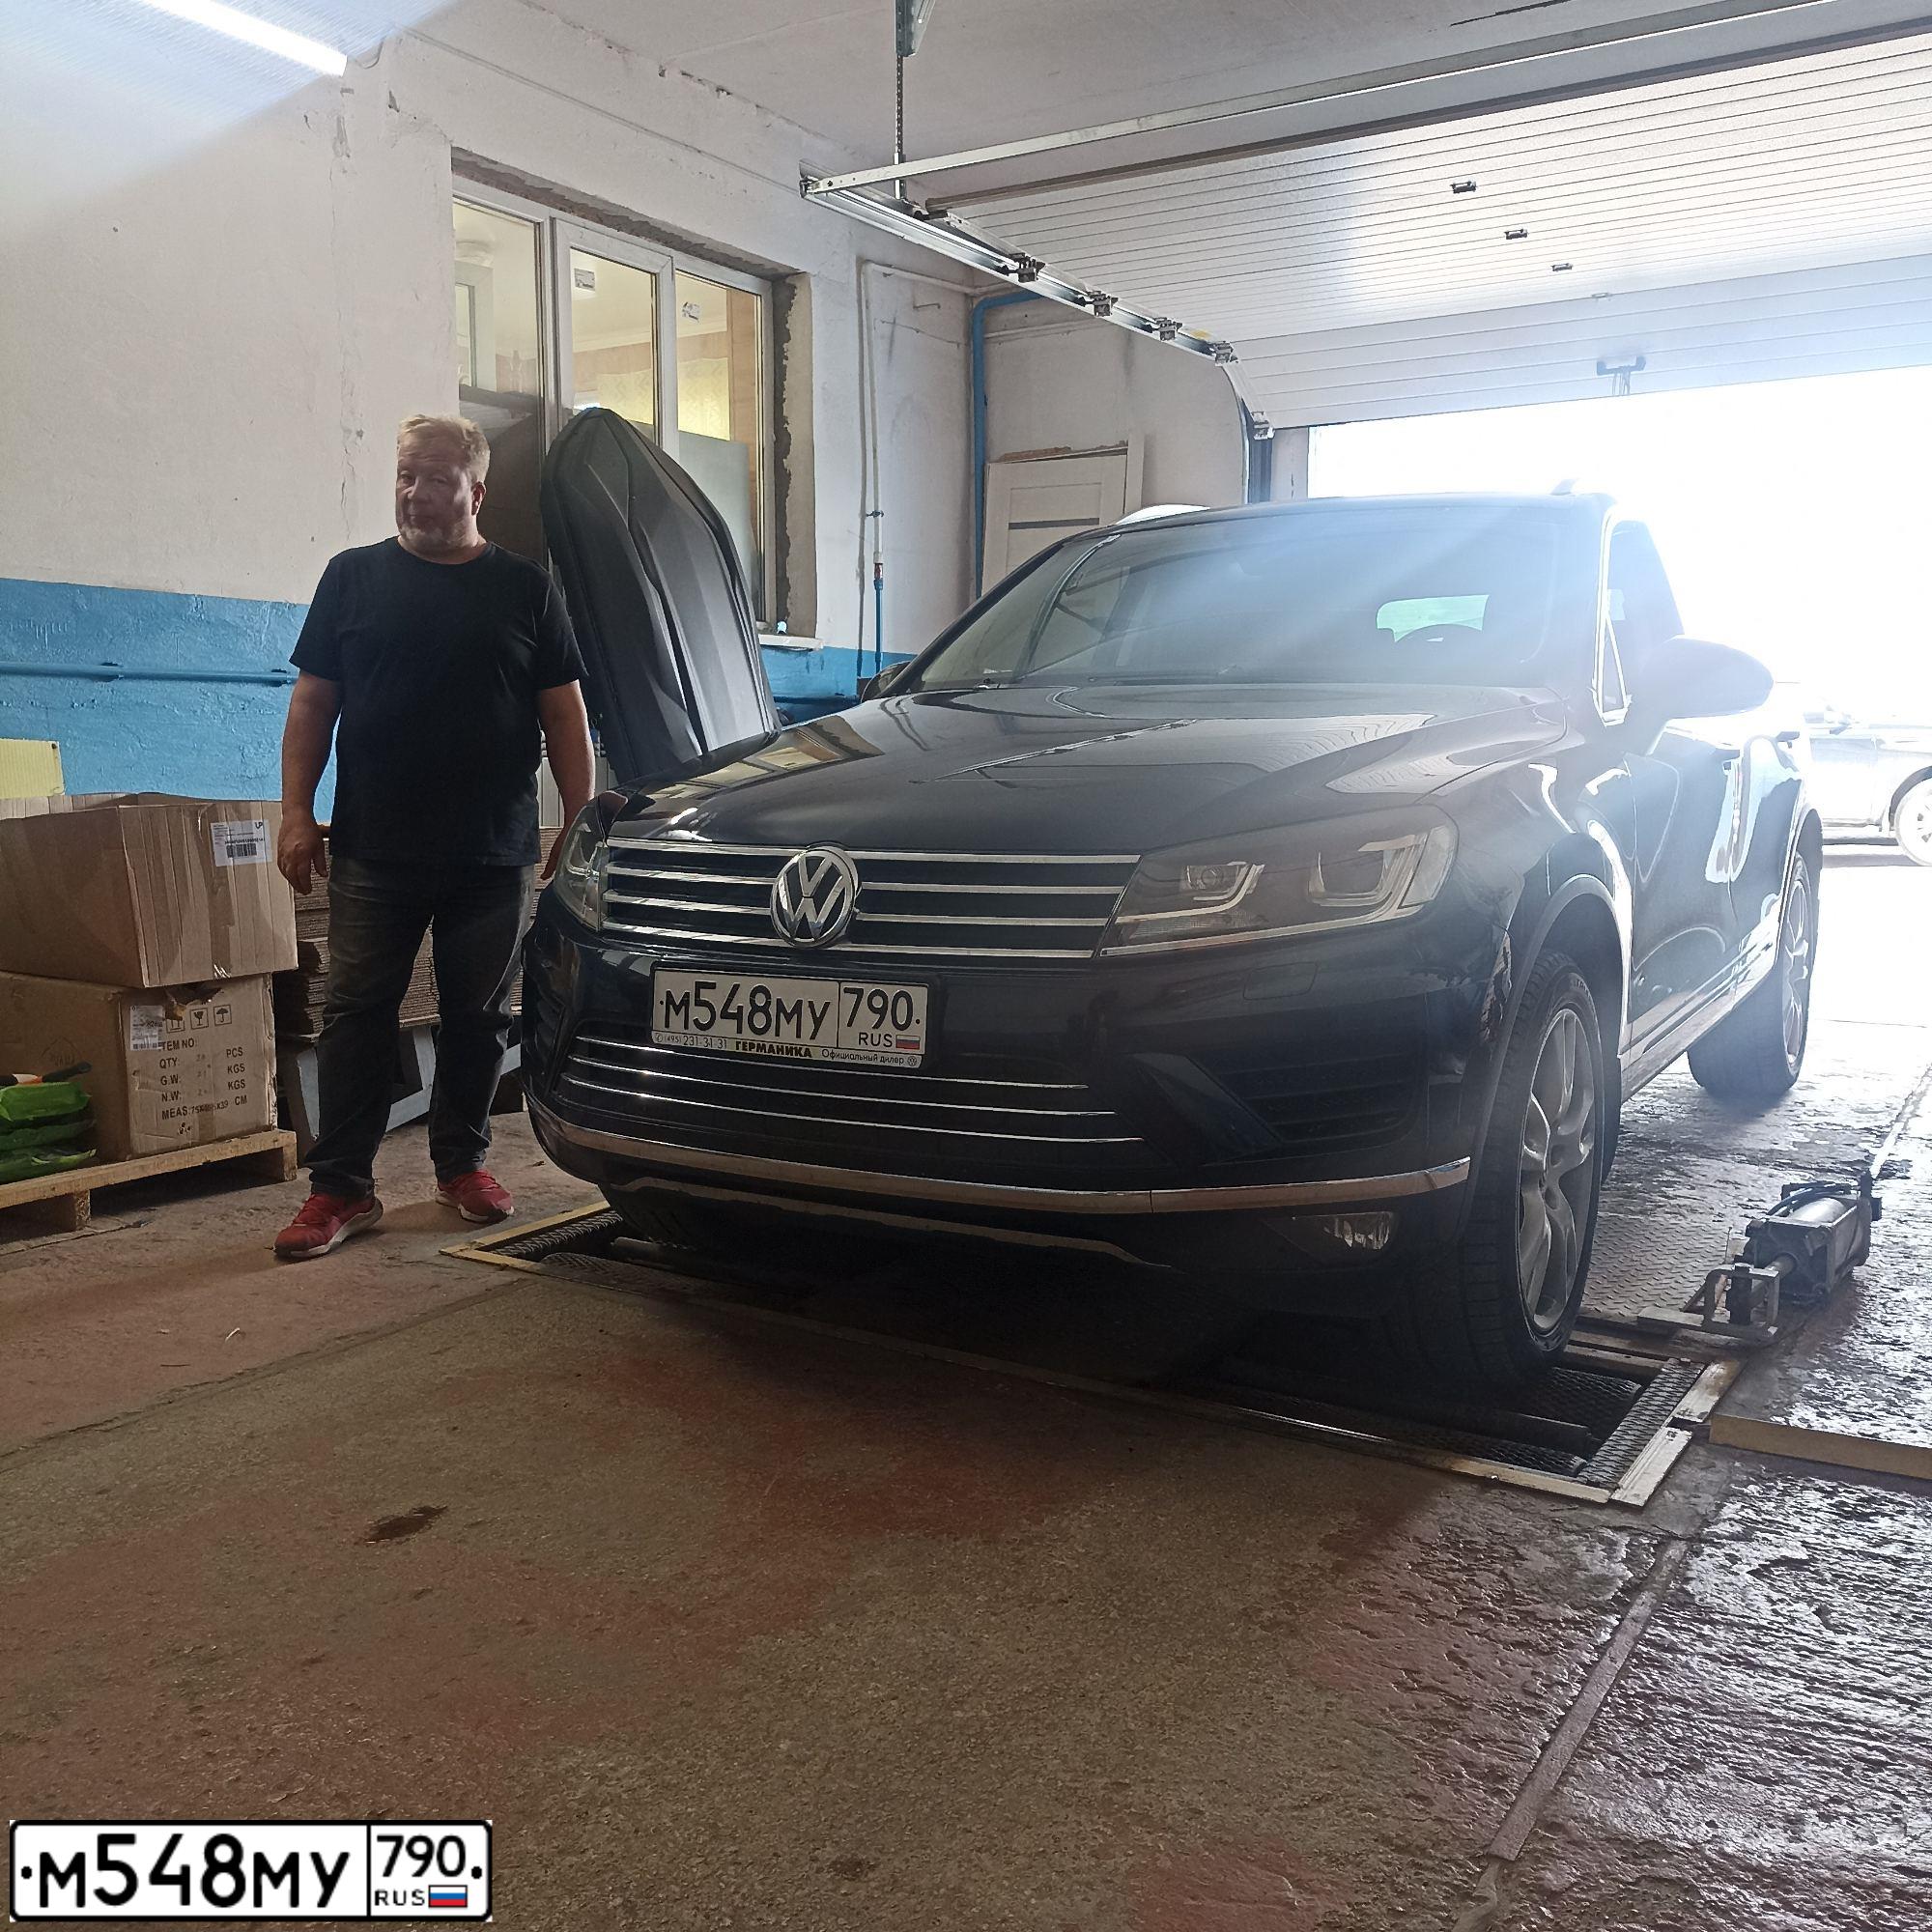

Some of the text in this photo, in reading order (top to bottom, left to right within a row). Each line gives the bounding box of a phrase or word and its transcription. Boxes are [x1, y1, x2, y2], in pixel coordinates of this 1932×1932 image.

[664, 980, 914, 1040] М548МУ 790
[858, 1032, 893, 1048] RUS
[226, 1046, 243, 1059] PCS
[735, 1040, 812, 1058] ГЕРМАНИКА
[821, 1048, 878, 1064] Официальный
[227, 1063, 245, 1074] KGS
[228, 1079, 246, 1091] KGS
[234, 1094, 247, 1106] CM
